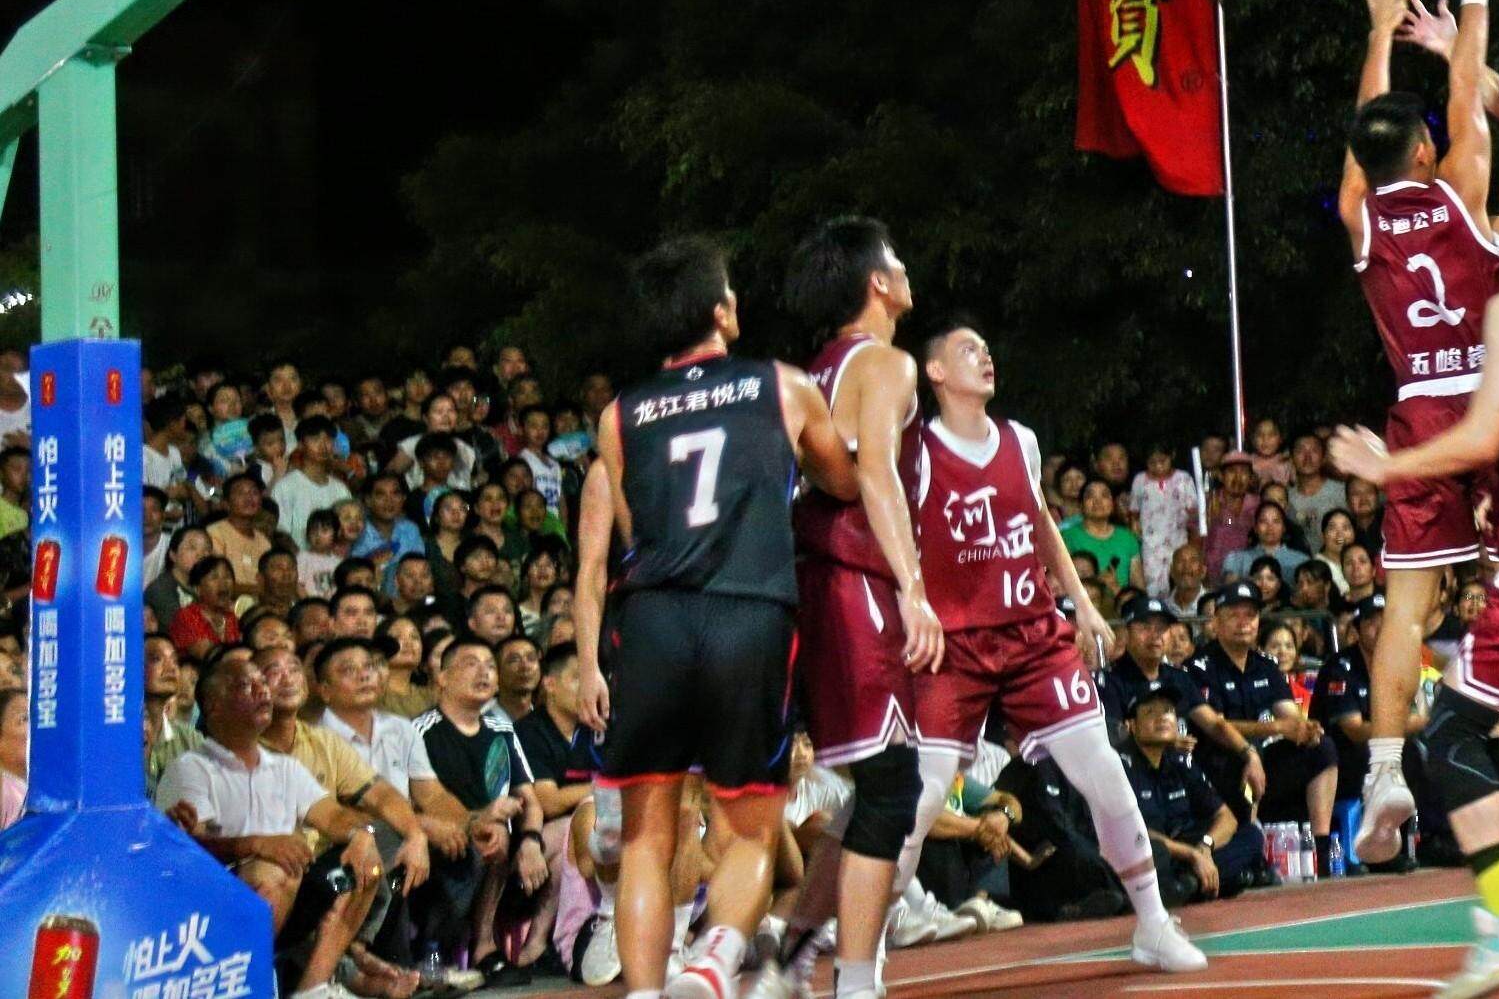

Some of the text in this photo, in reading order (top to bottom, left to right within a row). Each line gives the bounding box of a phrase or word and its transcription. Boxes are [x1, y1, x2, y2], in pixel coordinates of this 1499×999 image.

[1406, 252, 1467, 328] 2
[633, 375, 762, 428] 龙江君悦湾
[104, 432, 126, 521] 怕上火
[668, 425, 728, 529] 7
[957, 545, 1003, 563] CHINA
[1003, 567, 1036, 609] 16
[1052, 668, 1091, 711] 16
[122, 912, 215, 986] 怕上火
